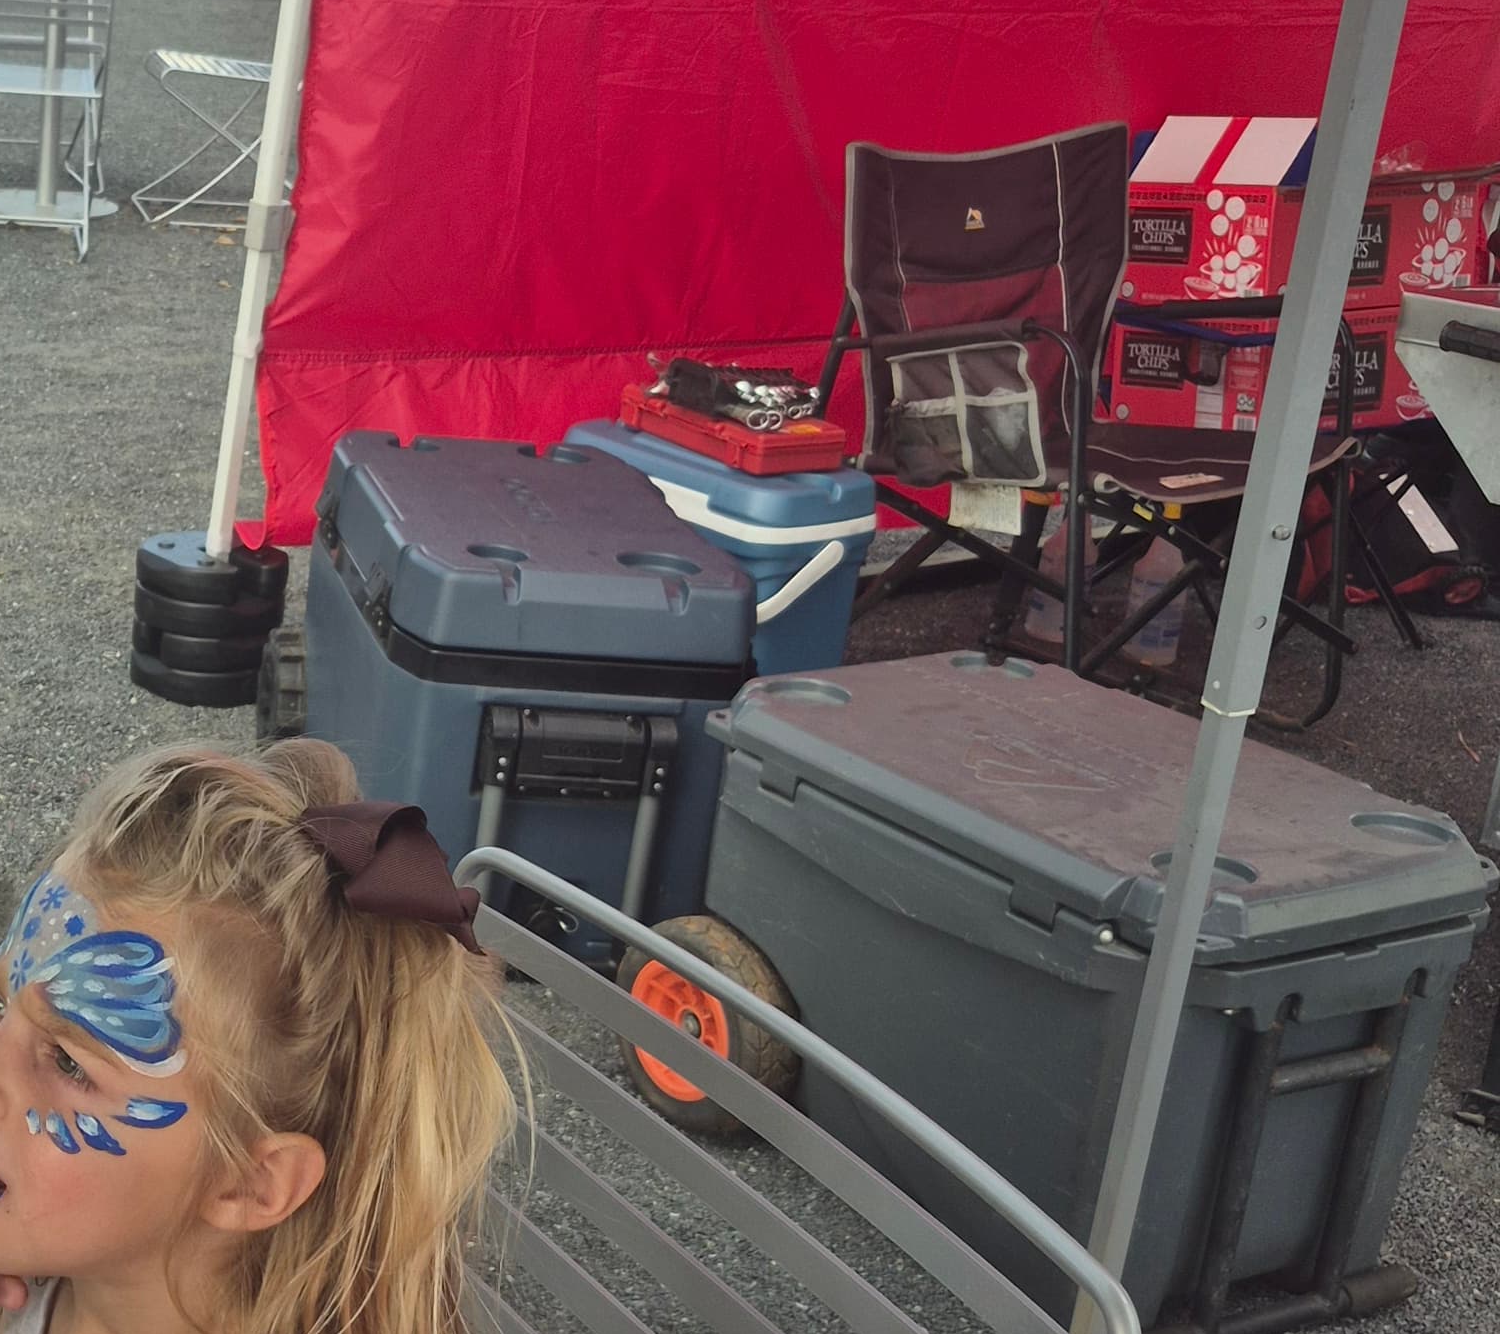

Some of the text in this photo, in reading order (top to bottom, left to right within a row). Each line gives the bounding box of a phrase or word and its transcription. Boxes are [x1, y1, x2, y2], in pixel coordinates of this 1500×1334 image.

[1132, 219, 1187, 236] TORTILLA
[1142, 231, 1175, 245] CHIPS
[1128, 344, 1181, 362] TORTILLA
[1137, 356, 1170, 370] CHIPS
